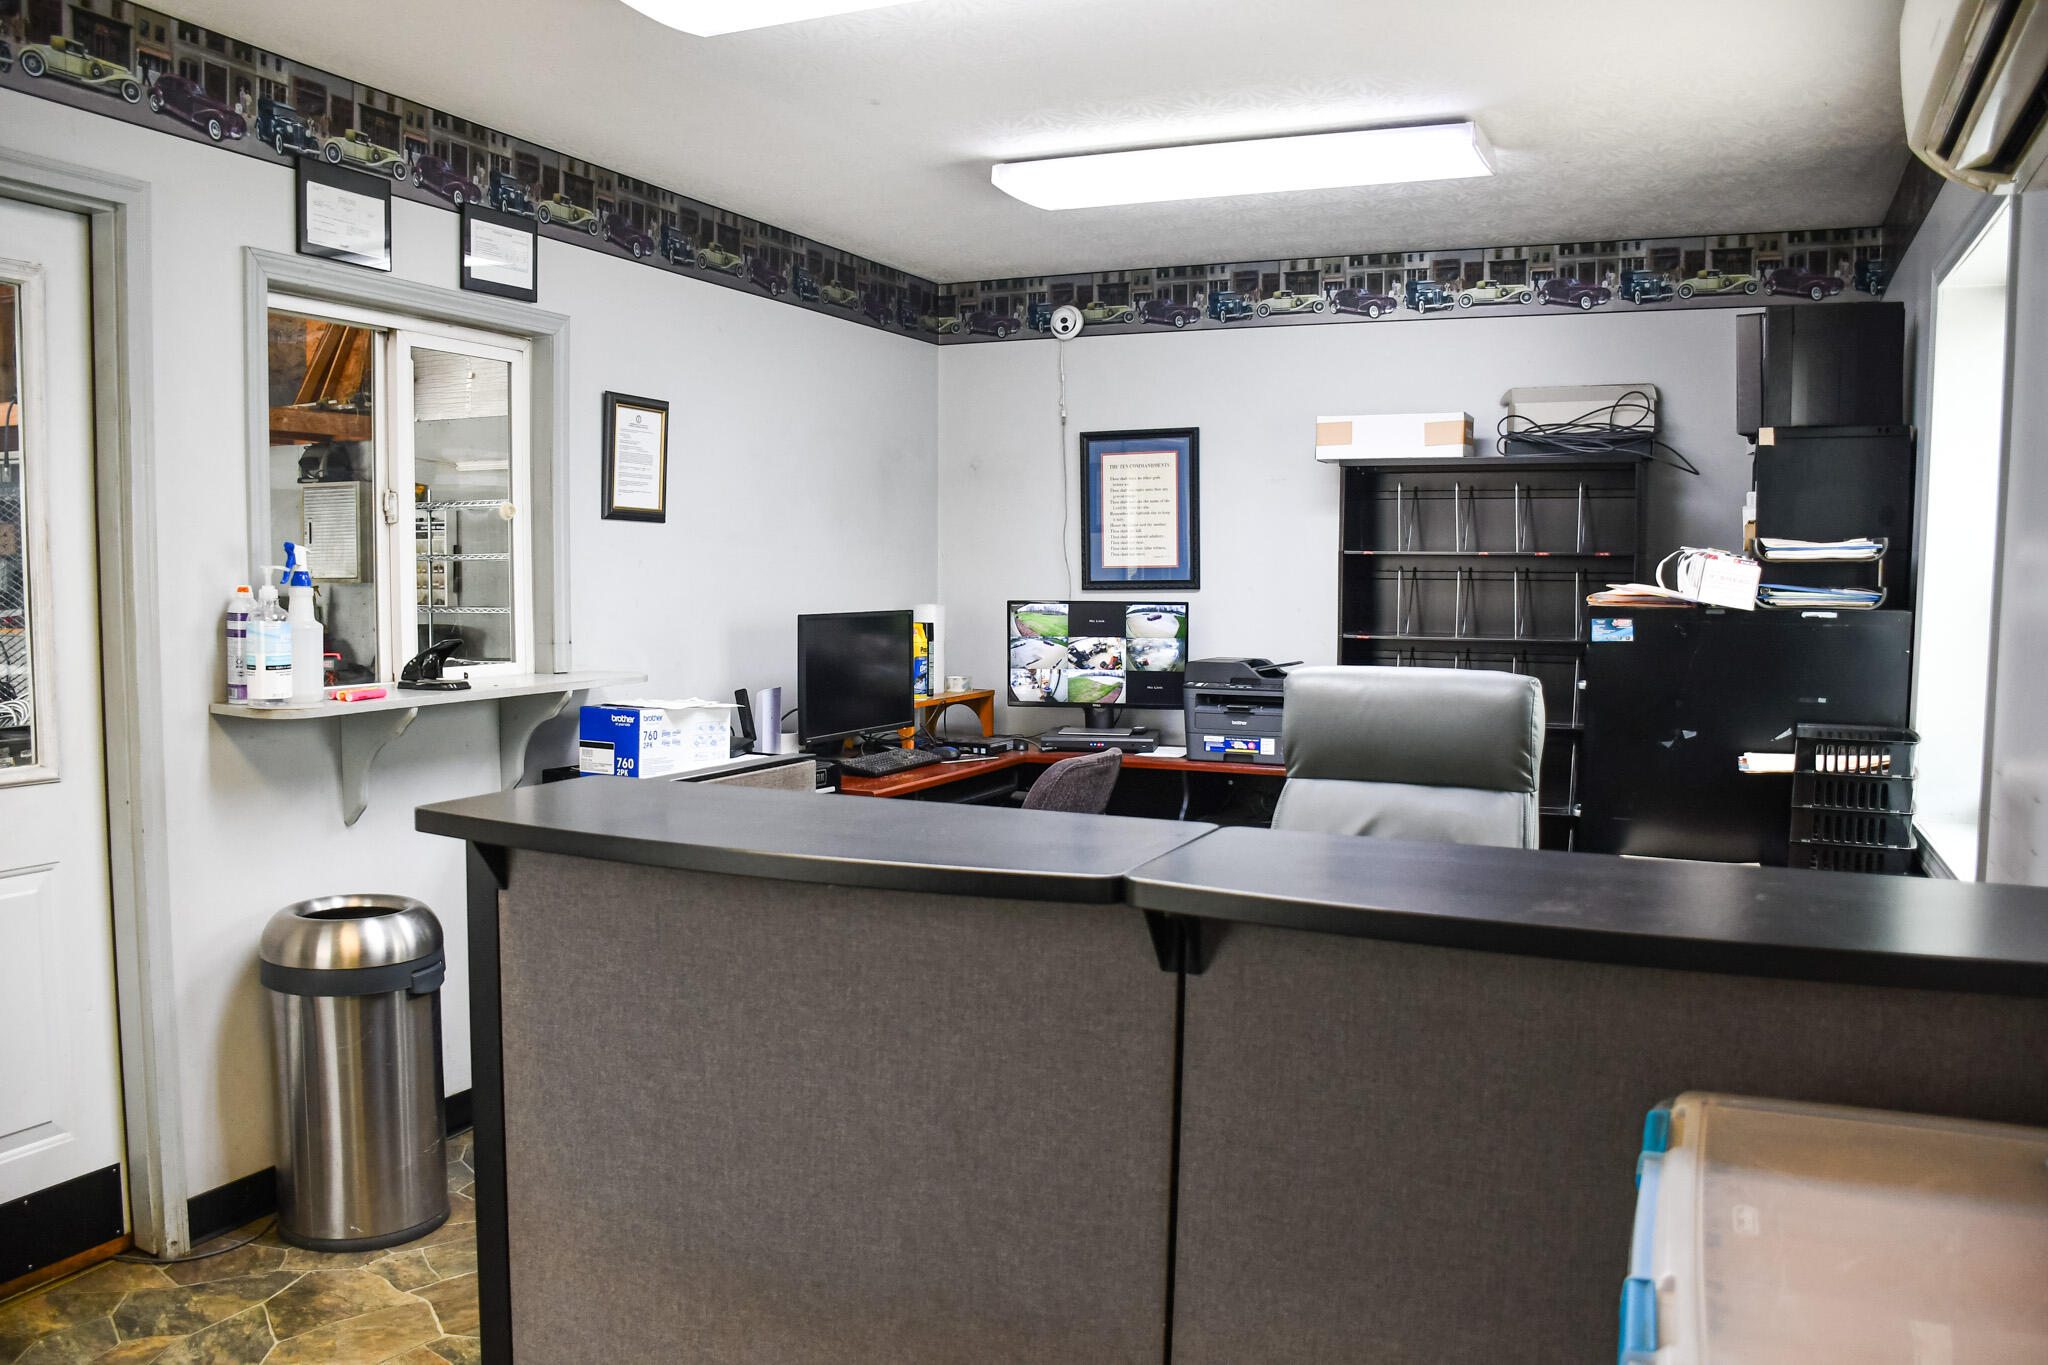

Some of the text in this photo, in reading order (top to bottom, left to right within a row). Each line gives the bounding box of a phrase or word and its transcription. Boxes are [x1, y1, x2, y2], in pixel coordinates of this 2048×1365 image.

[611, 714, 635, 723] brother
[643, 730, 658, 741] 760
[616, 757, 634, 769] 760
[616, 768, 629, 777] 2PK
